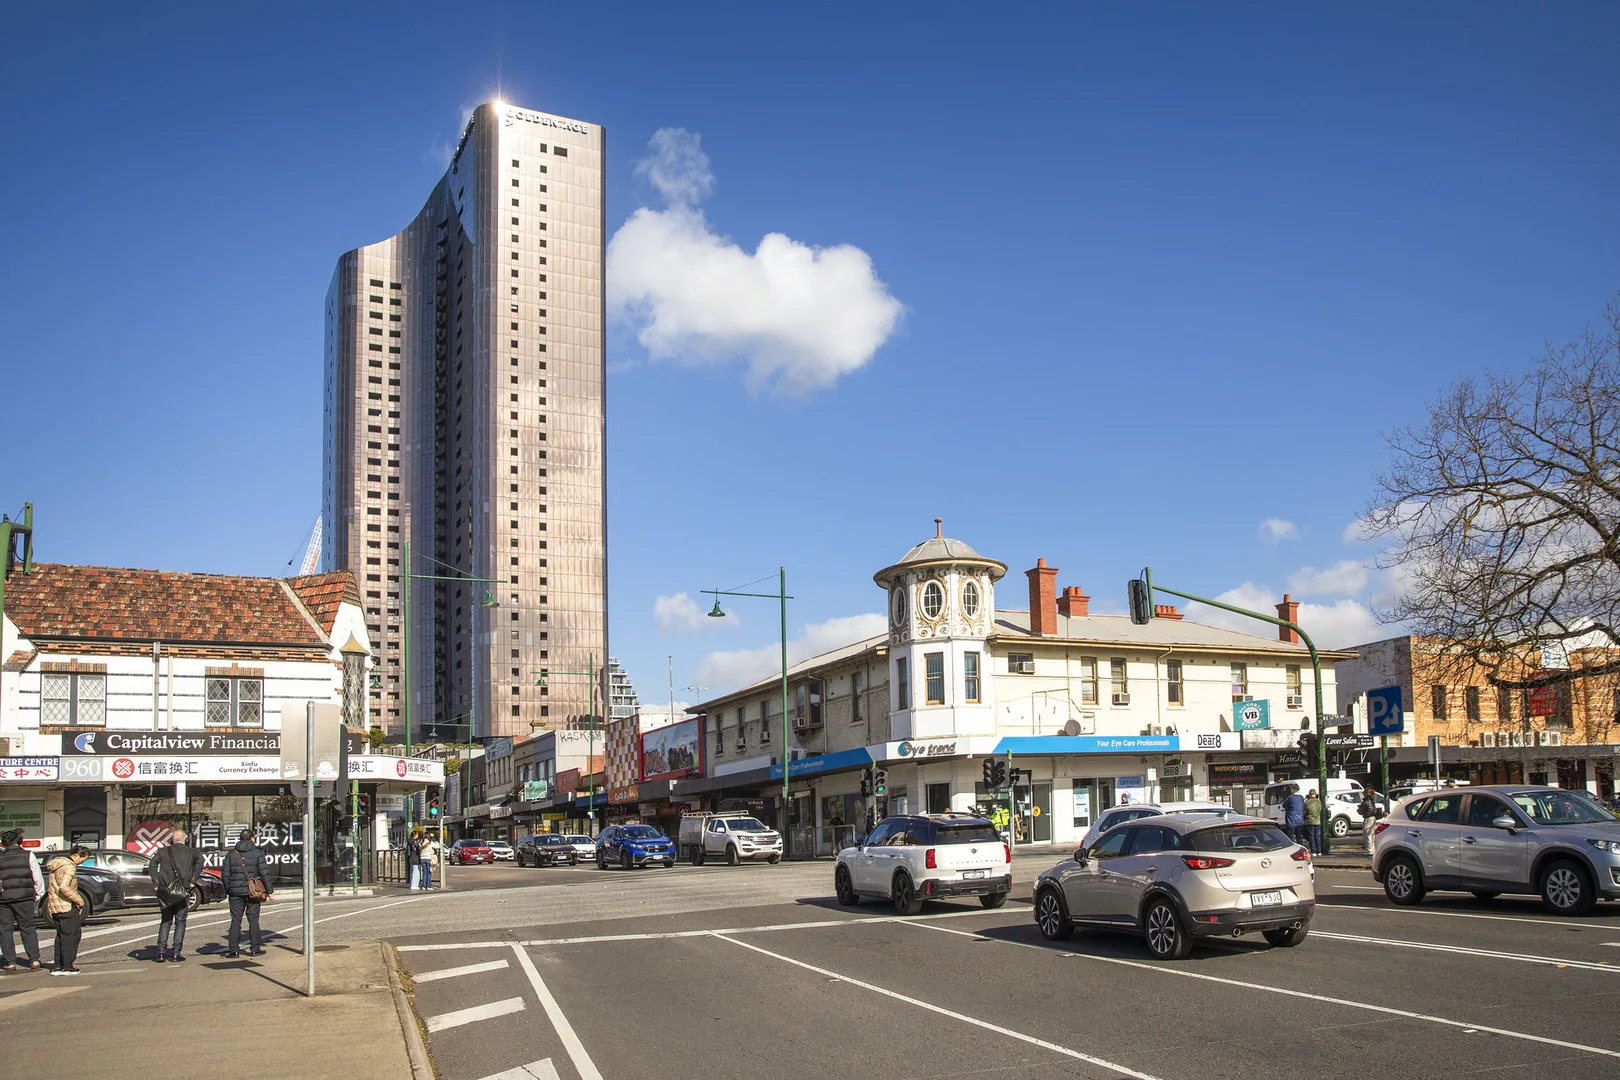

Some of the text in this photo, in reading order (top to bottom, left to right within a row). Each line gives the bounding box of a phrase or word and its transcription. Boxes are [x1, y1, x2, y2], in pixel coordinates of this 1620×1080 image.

[505, 109, 588, 135] GOLDEN AGE
[1239, 702, 1263, 714] VICTORIA
[1369, 696, 1388, 729] P
[1244, 711, 1258, 720] VB
[1241, 720, 1262, 728] BITTER
[106, 734, 281, 752] Capitalview Financial
[1097, 739, 1109, 747] Your
[1123, 739, 1136, 747] Care
[1137, 739, 1170, 747] Professionals
[1342, 736, 1357, 745] Salon
[25, 758, 58, 766] CENTRE
[65, 760, 100, 777] 960
[138, 762, 198, 775] 信富换汇
[407, 763, 432, 774] 信富换汇
[264, 853, 300, 865] orex
